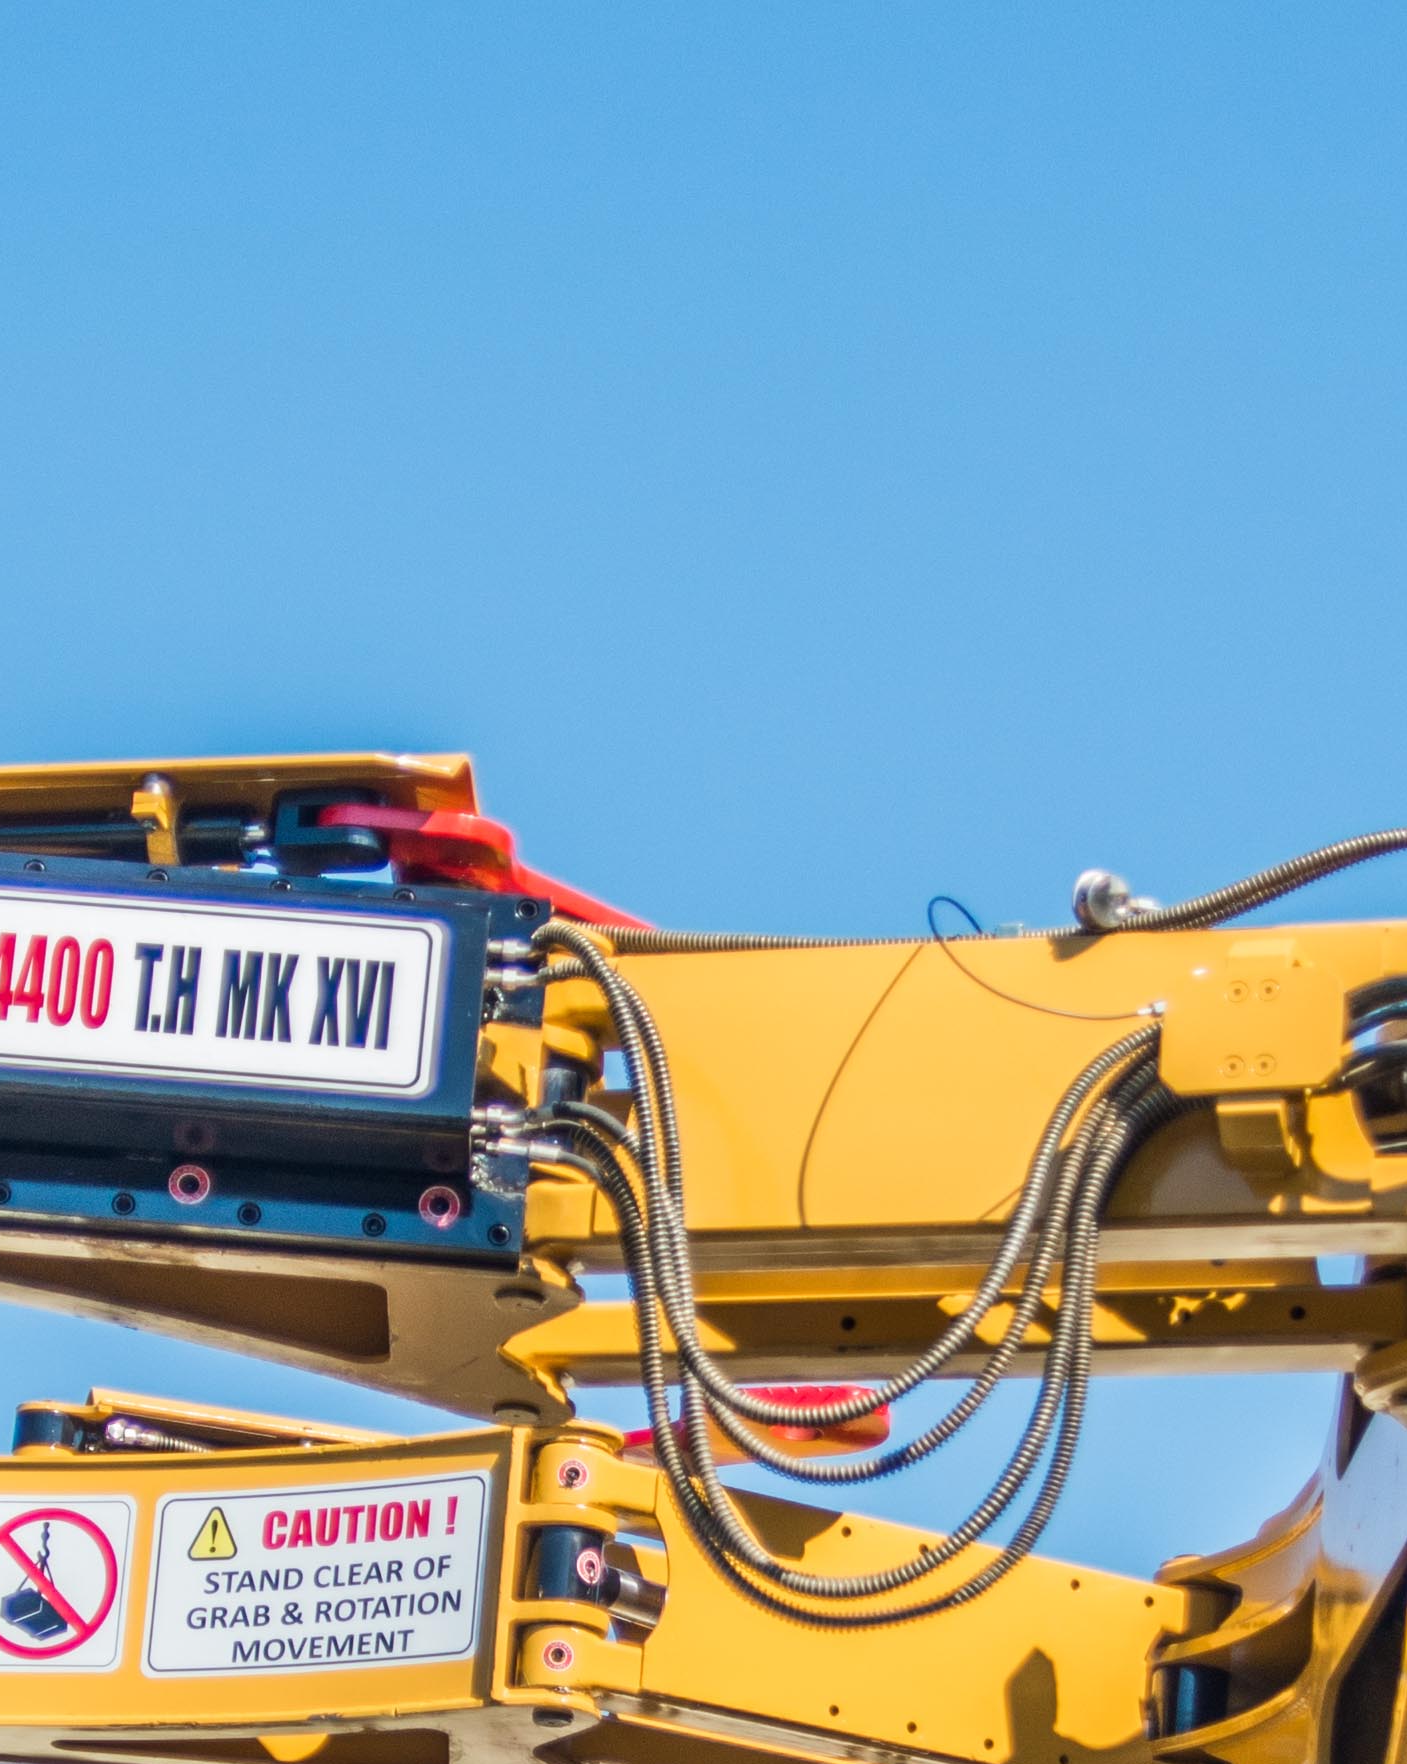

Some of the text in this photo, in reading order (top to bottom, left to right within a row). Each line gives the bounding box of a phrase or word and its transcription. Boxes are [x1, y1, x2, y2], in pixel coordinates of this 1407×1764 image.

[134, 942, 202, 1035] T.H
[215, 949, 300, 1043] MK
[308, 956, 396, 1050] XVI
[262, 1498, 431, 1550] CAUTION
[203, 1555, 452, 1594] STAND CLEAR OF
[186, 1589, 462, 1630] GRAB & ROTATION
[232, 1629, 414, 1663] MOVEMENT
